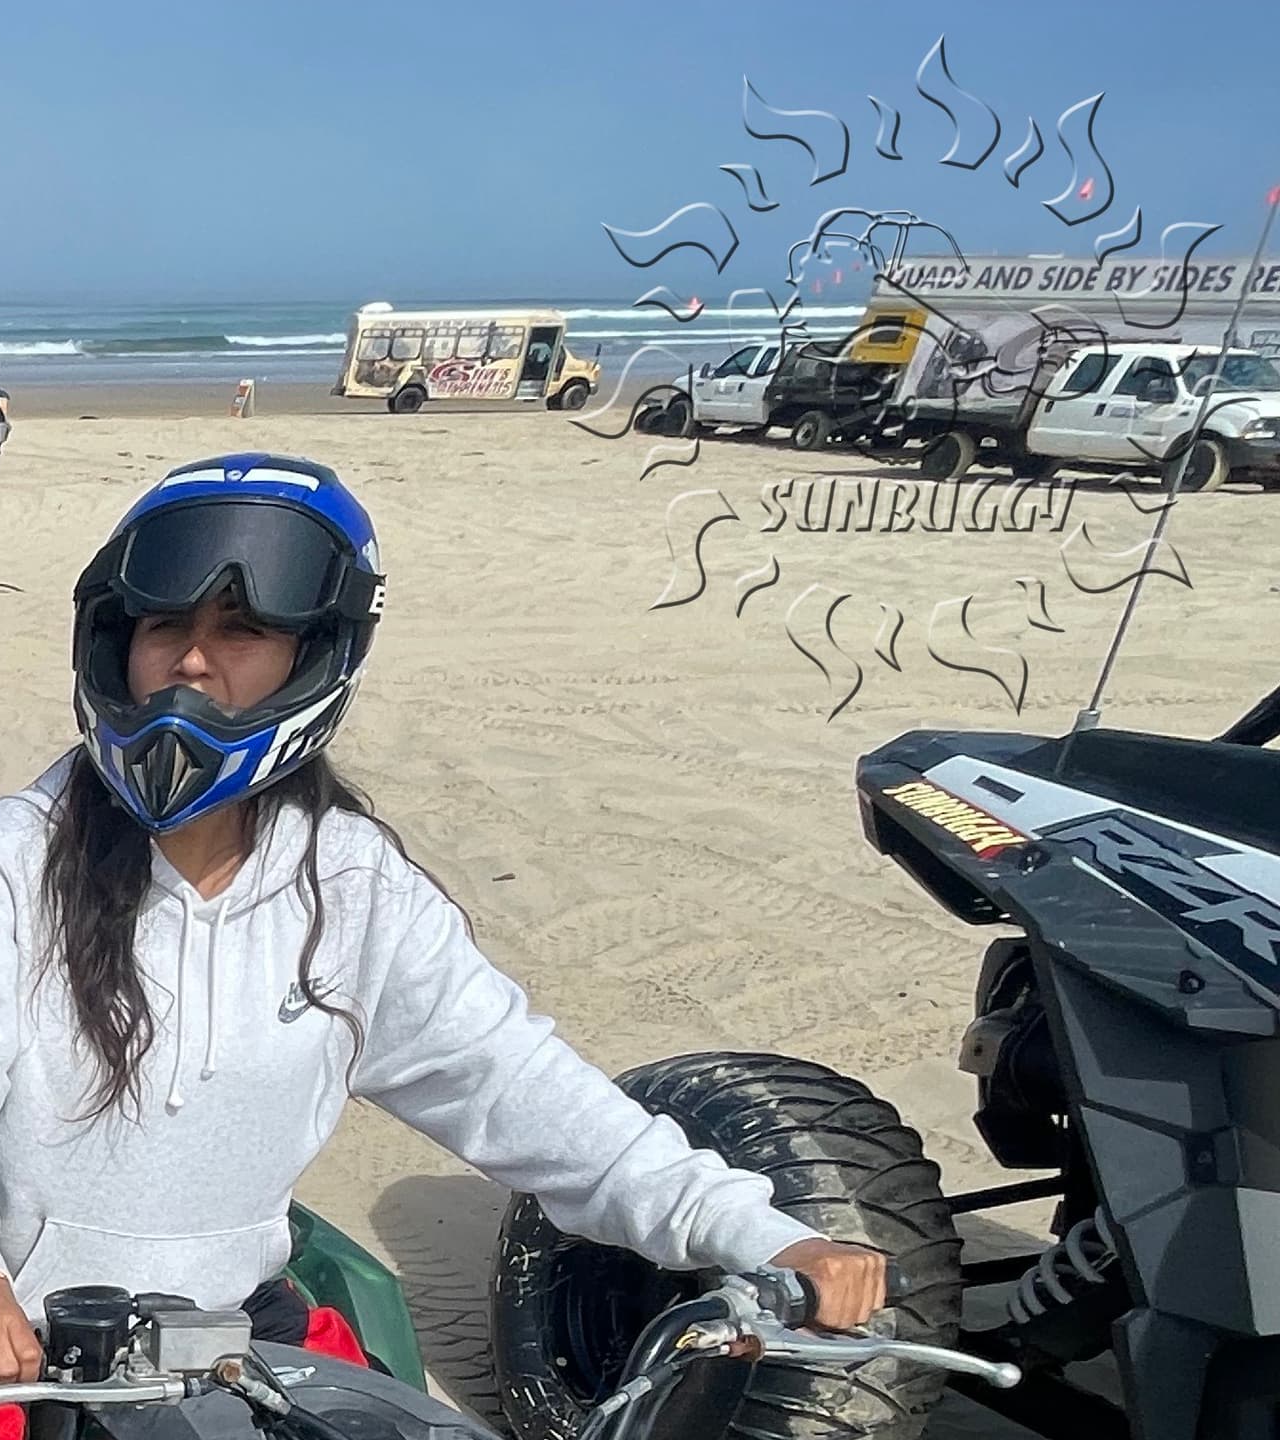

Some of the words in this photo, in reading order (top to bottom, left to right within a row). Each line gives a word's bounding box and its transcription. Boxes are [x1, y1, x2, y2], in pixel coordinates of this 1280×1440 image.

[888, 264, 971, 290] QUADS
[974, 265, 1033, 290] AND
[1038, 265, 1100, 291] SIDE
[1106, 265, 1147, 292] BY
[1151, 265, 1237, 293] SIDES
[881, 782, 1028, 853] SUNBUGGY
